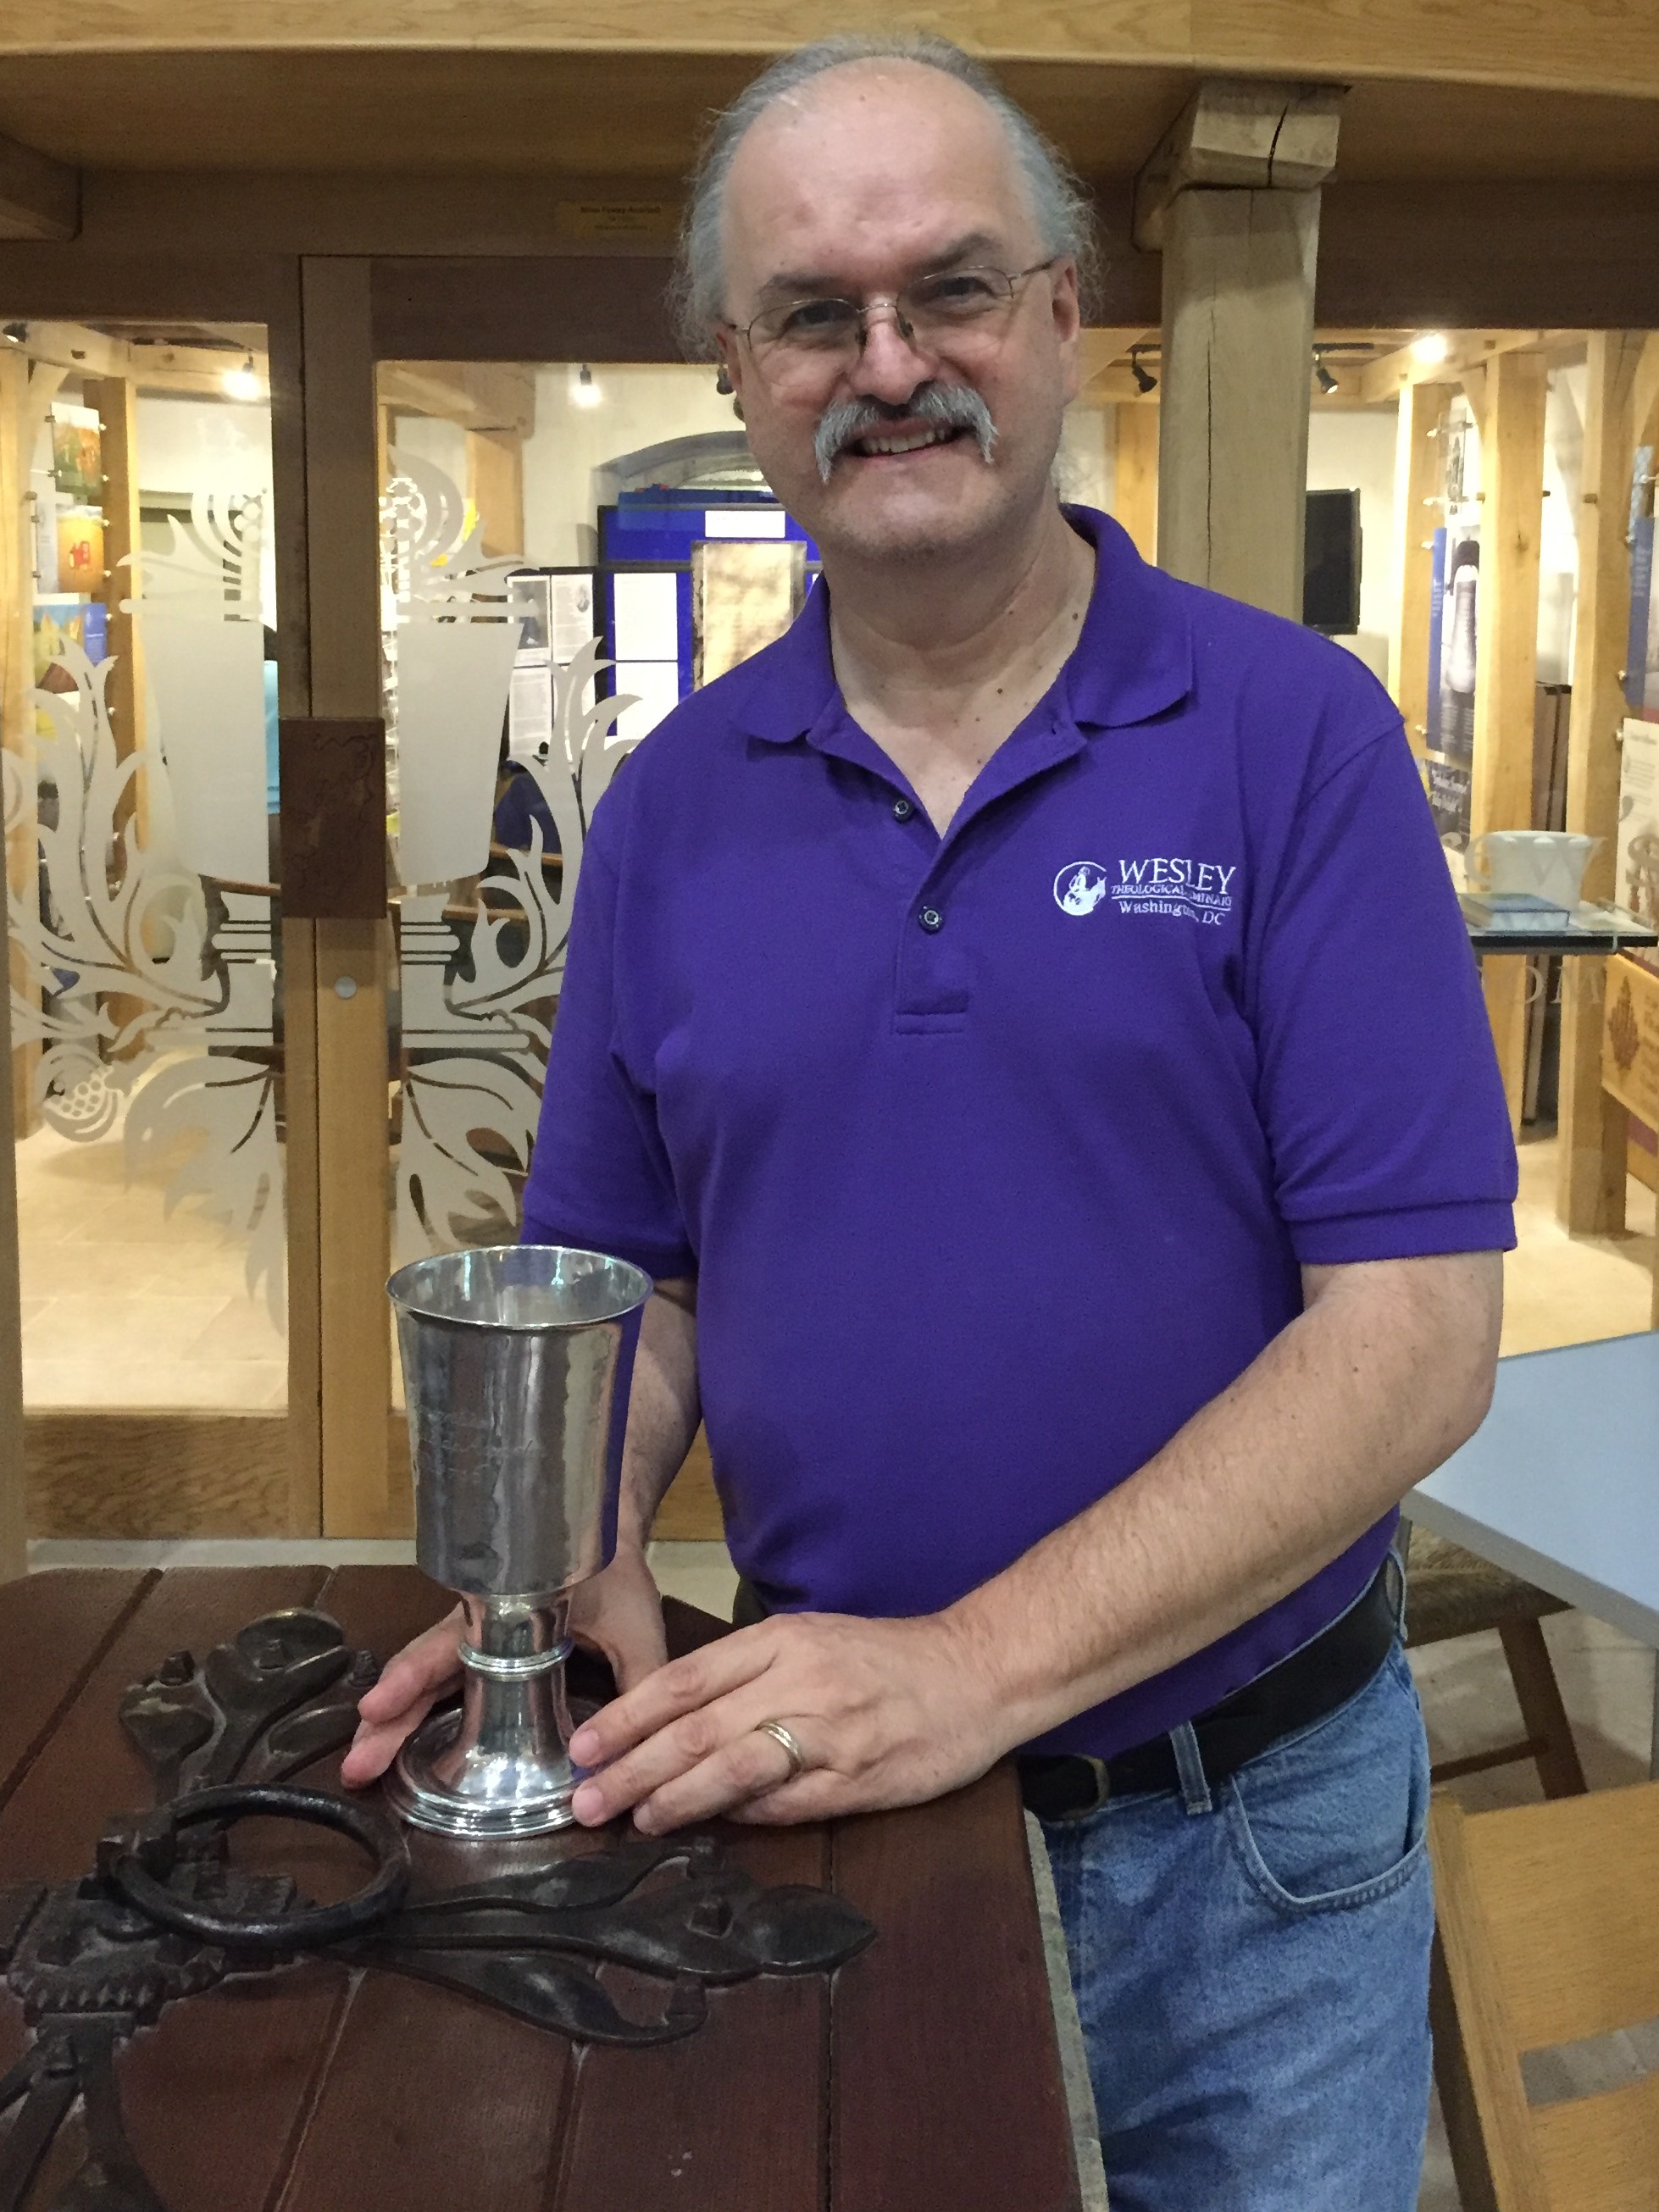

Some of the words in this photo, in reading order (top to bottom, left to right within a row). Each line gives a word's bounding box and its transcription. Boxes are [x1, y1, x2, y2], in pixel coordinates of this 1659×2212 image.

[1118, 857, 1236, 895] WESLEY
[1110, 884, 1186, 896] THEOLOGICAL
[1186, 890, 1233, 907] MINARY
[1201, 911, 1226, 925] DC
